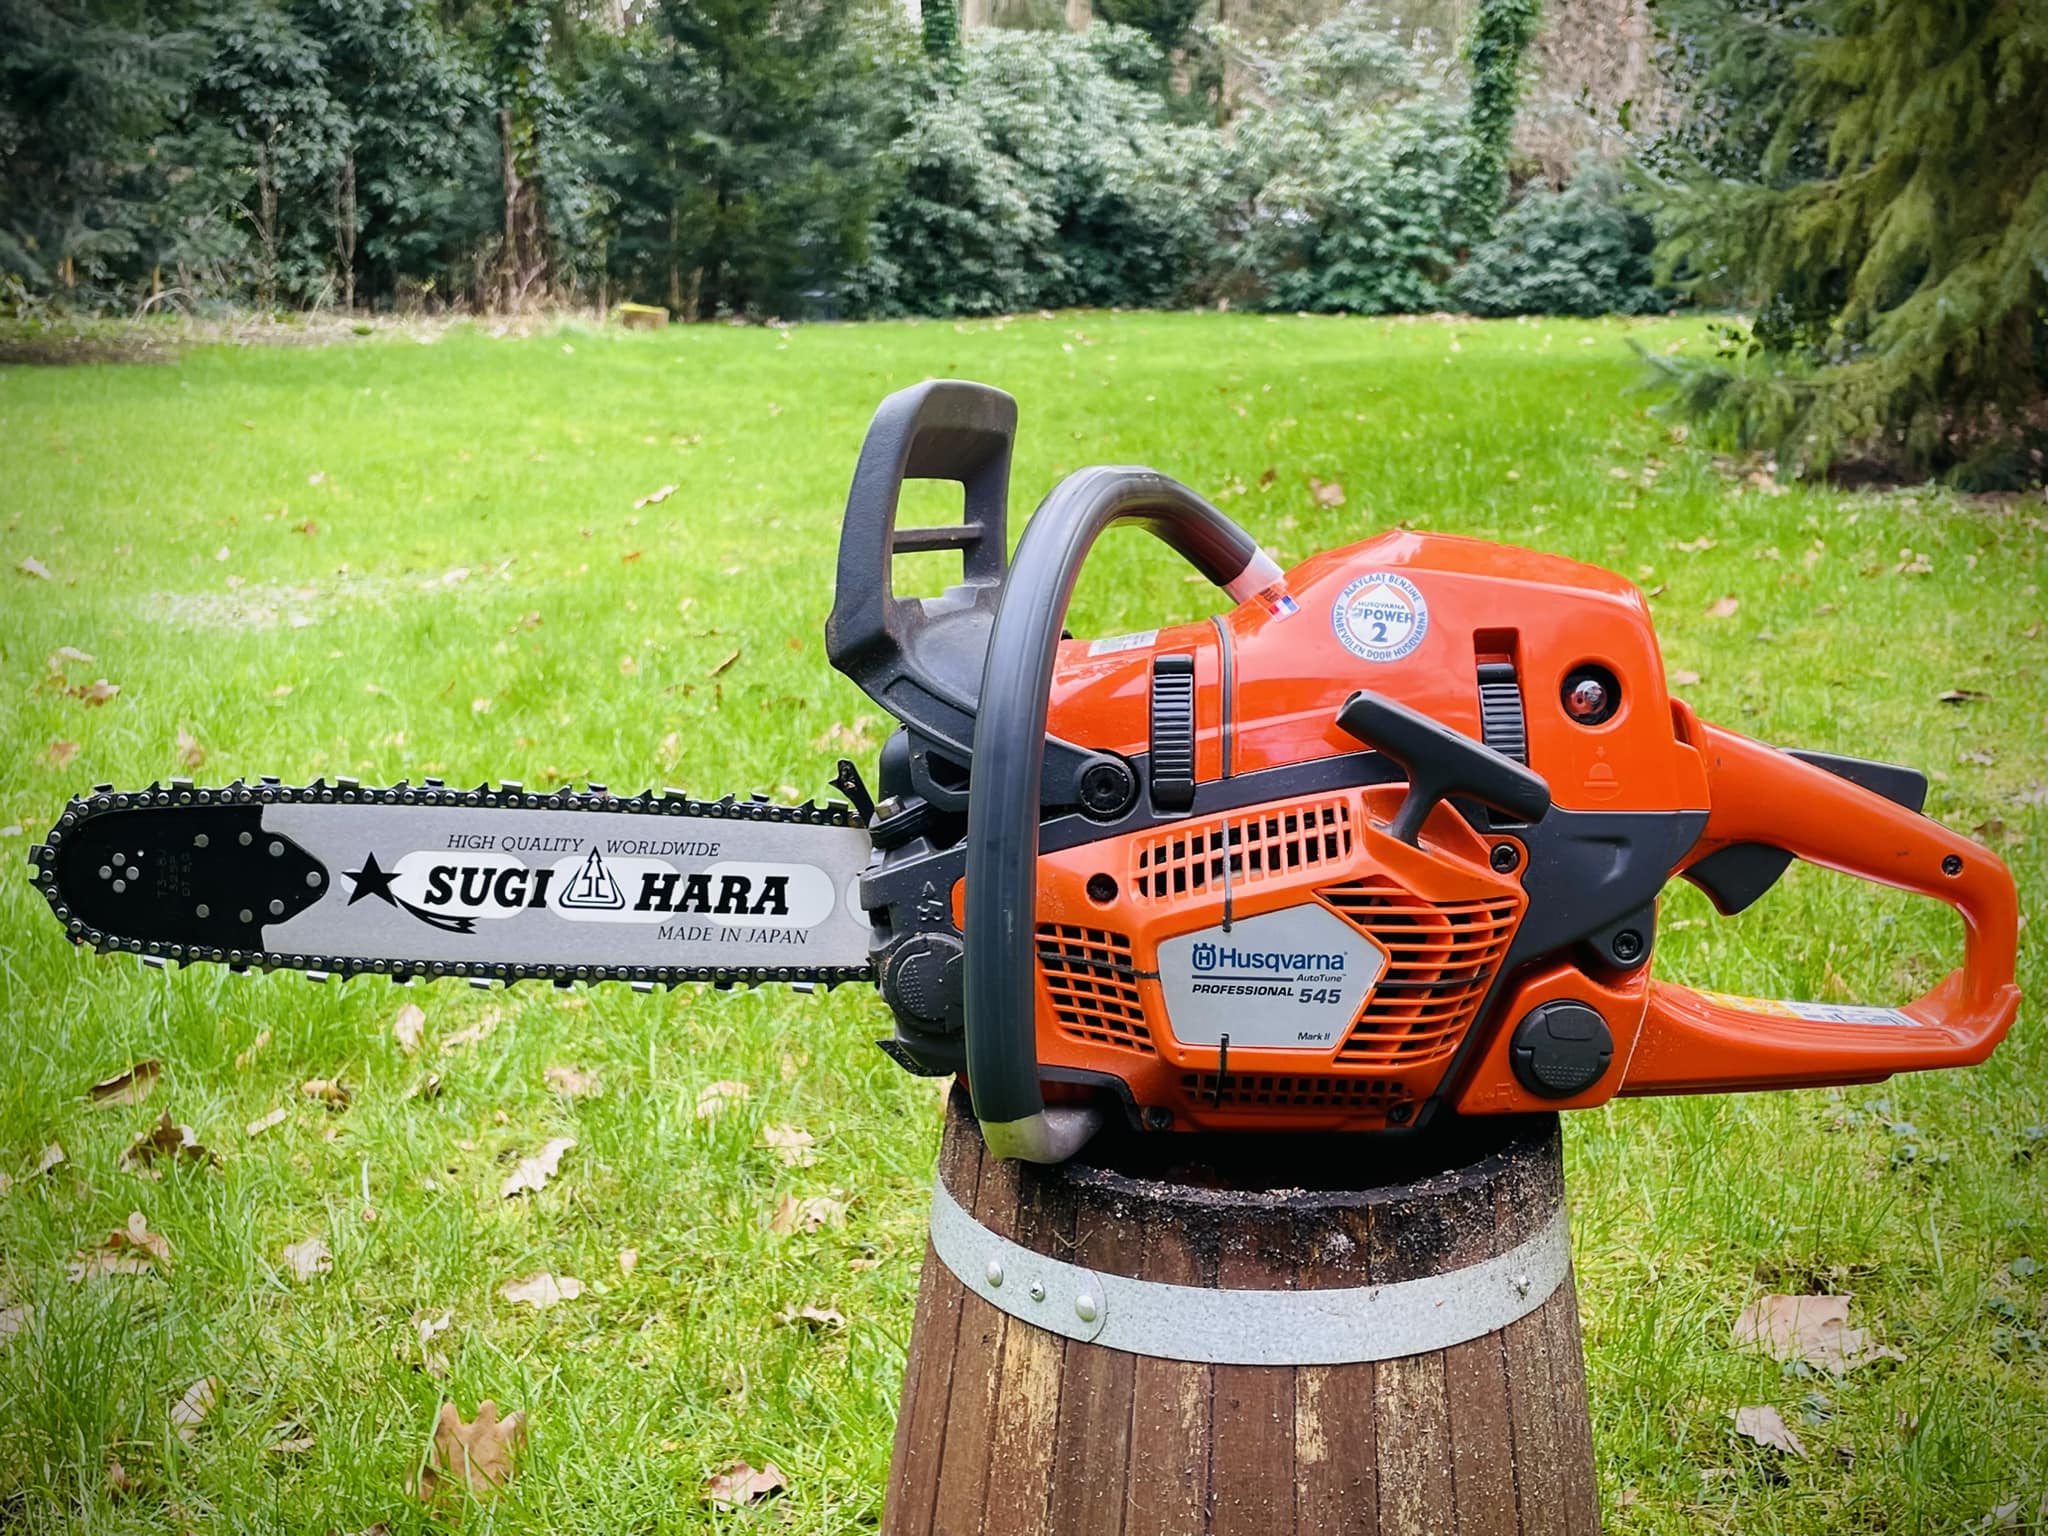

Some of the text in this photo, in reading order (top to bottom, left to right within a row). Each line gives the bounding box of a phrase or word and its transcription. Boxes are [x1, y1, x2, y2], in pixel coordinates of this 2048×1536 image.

[1343, 573, 1422, 602] ALKYLAAT BENZINE
[1335, 604, 1427, 660] AANBEVOLEN DOOR HUSQVARNA
[1370, 622, 1388, 643] 2
[447, 834, 721, 857] HIGH QUALITY WORLDWIDE
[423, 865, 790, 915] SUGI HARA
[656, 925, 809, 945] MADE IN JAPAN
[1218, 947, 1344, 973] Husqvarna
[1192, 984, 1342, 1004] PROFESSIONAL 545
[1297, 1031, 1323, 1041] Mark
